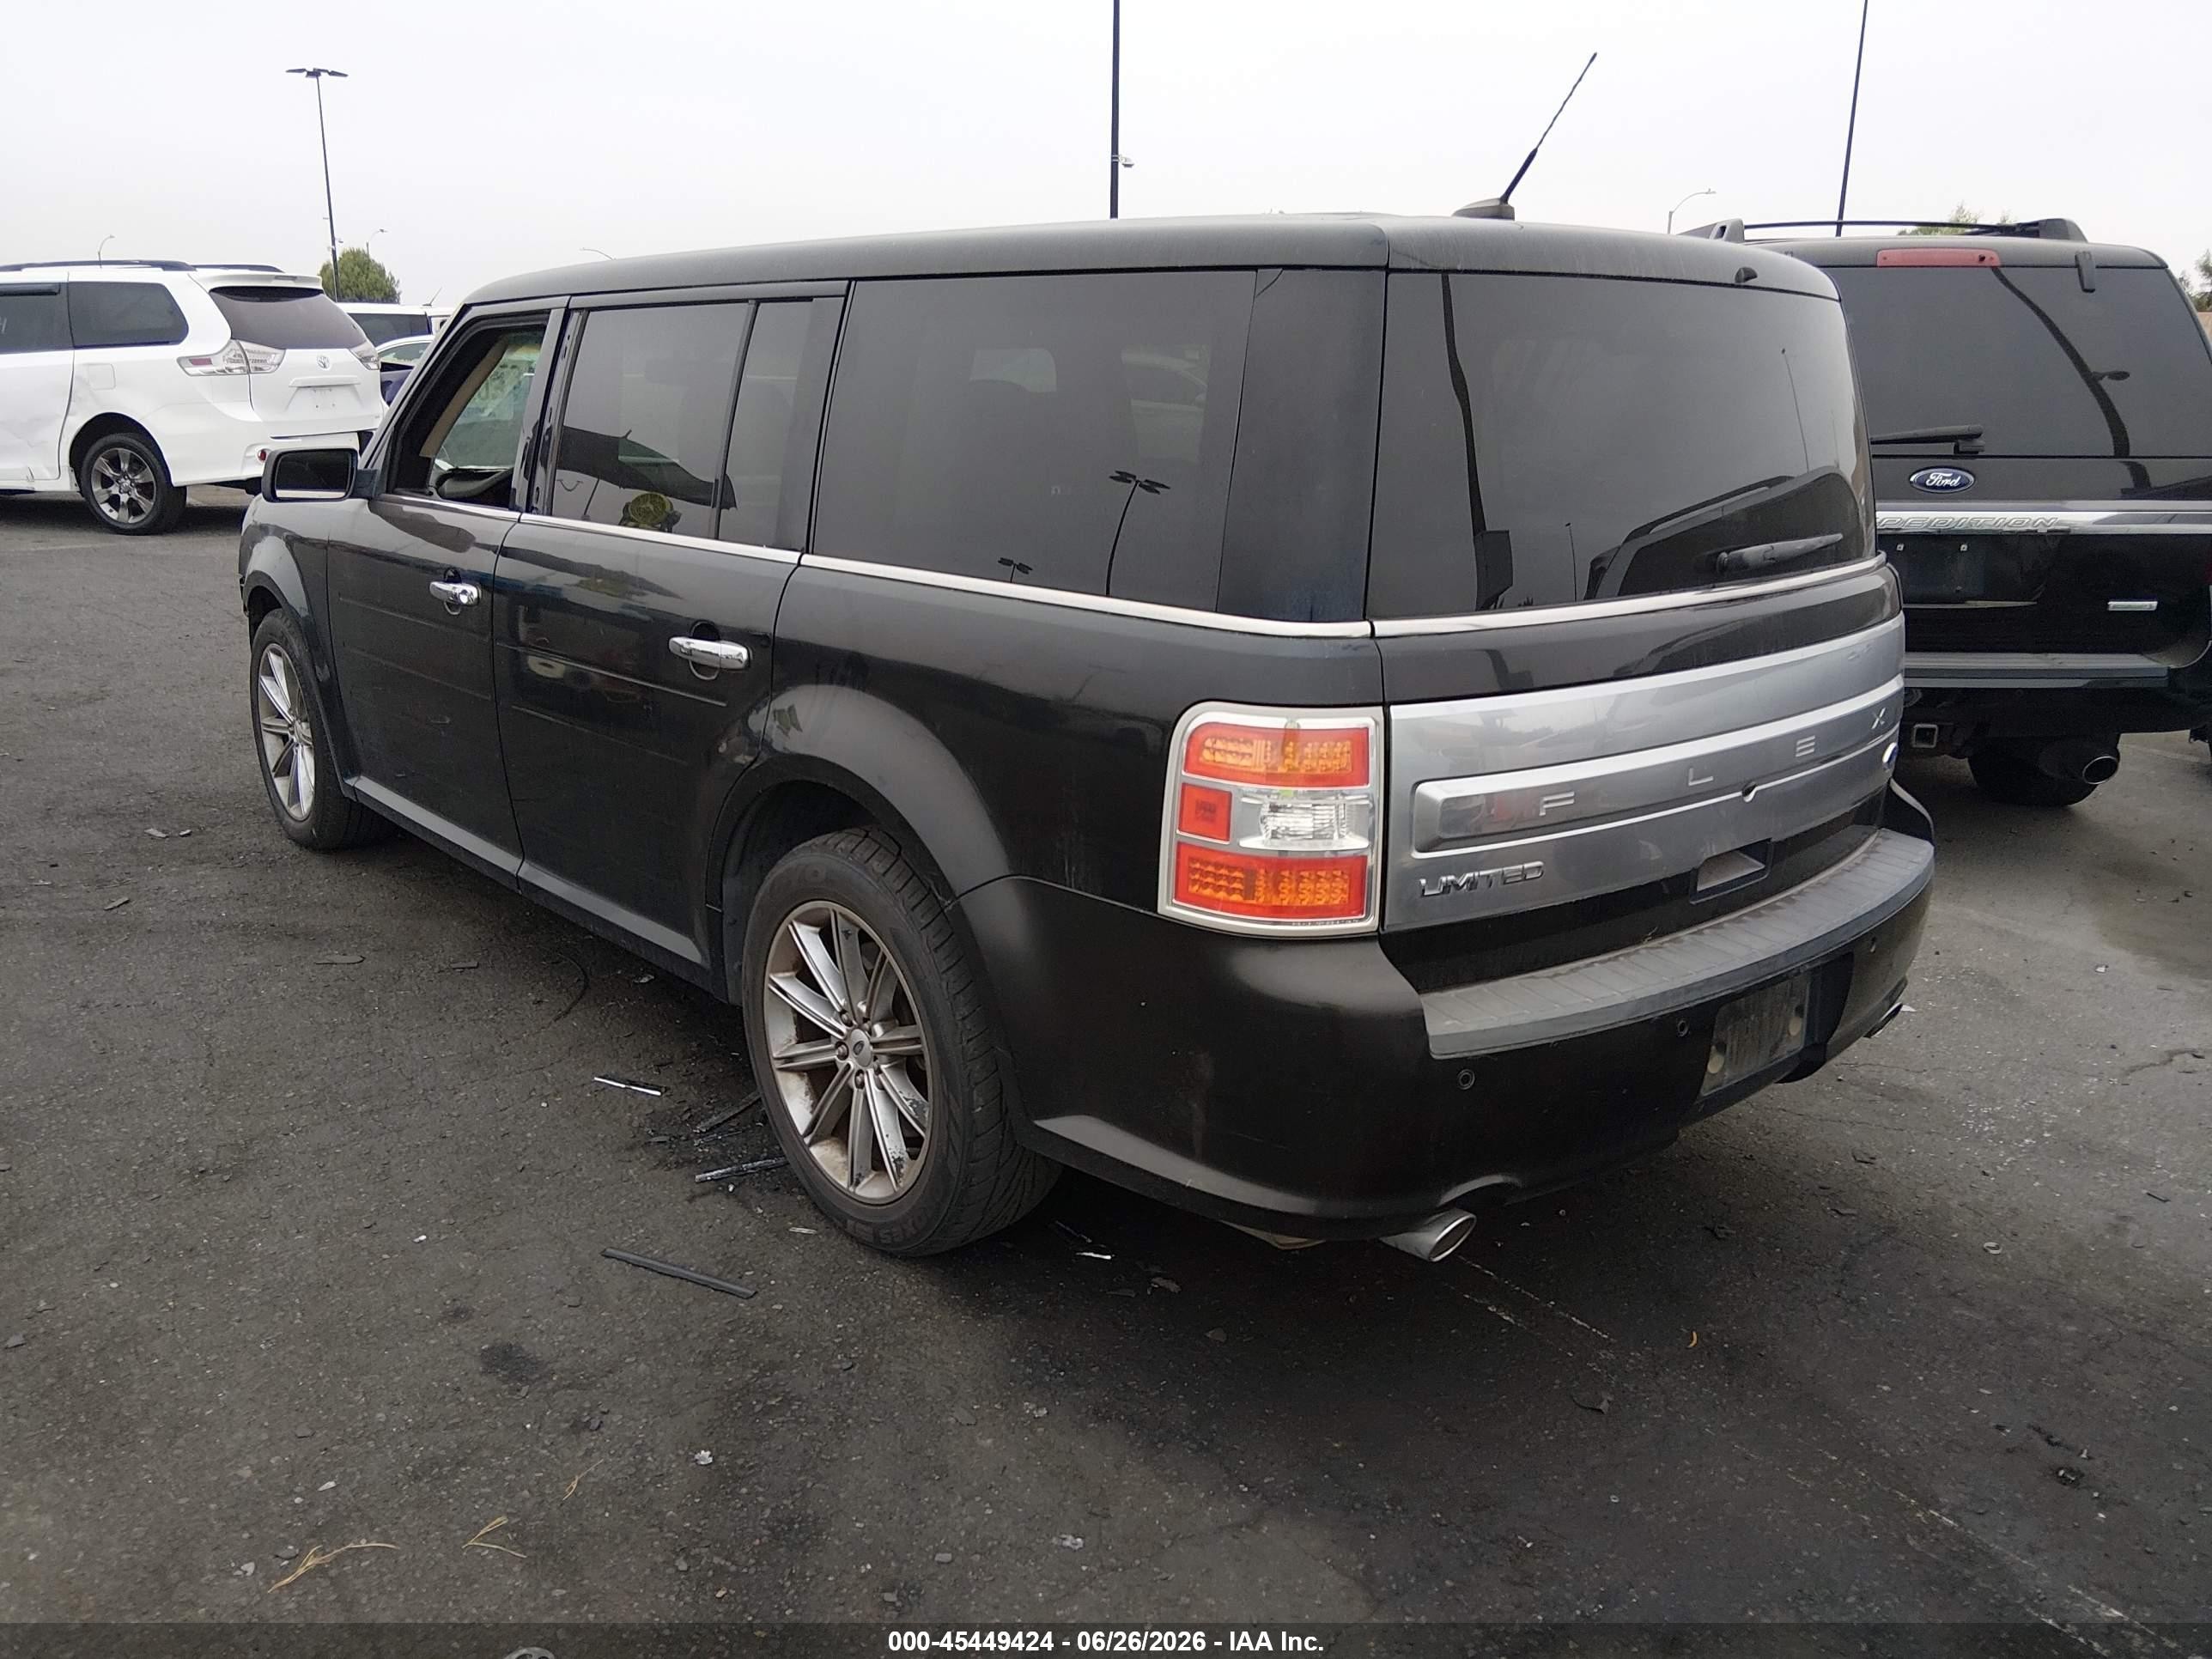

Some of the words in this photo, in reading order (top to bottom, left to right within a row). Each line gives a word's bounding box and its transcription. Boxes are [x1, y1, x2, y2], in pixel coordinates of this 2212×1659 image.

[1925, 471, 1961, 486] Ford
[1875, 517, 2059, 529] PEDITION
[1539, 708, 1886, 816] FLEX
[1420, 861, 1544, 896] LIMITED
